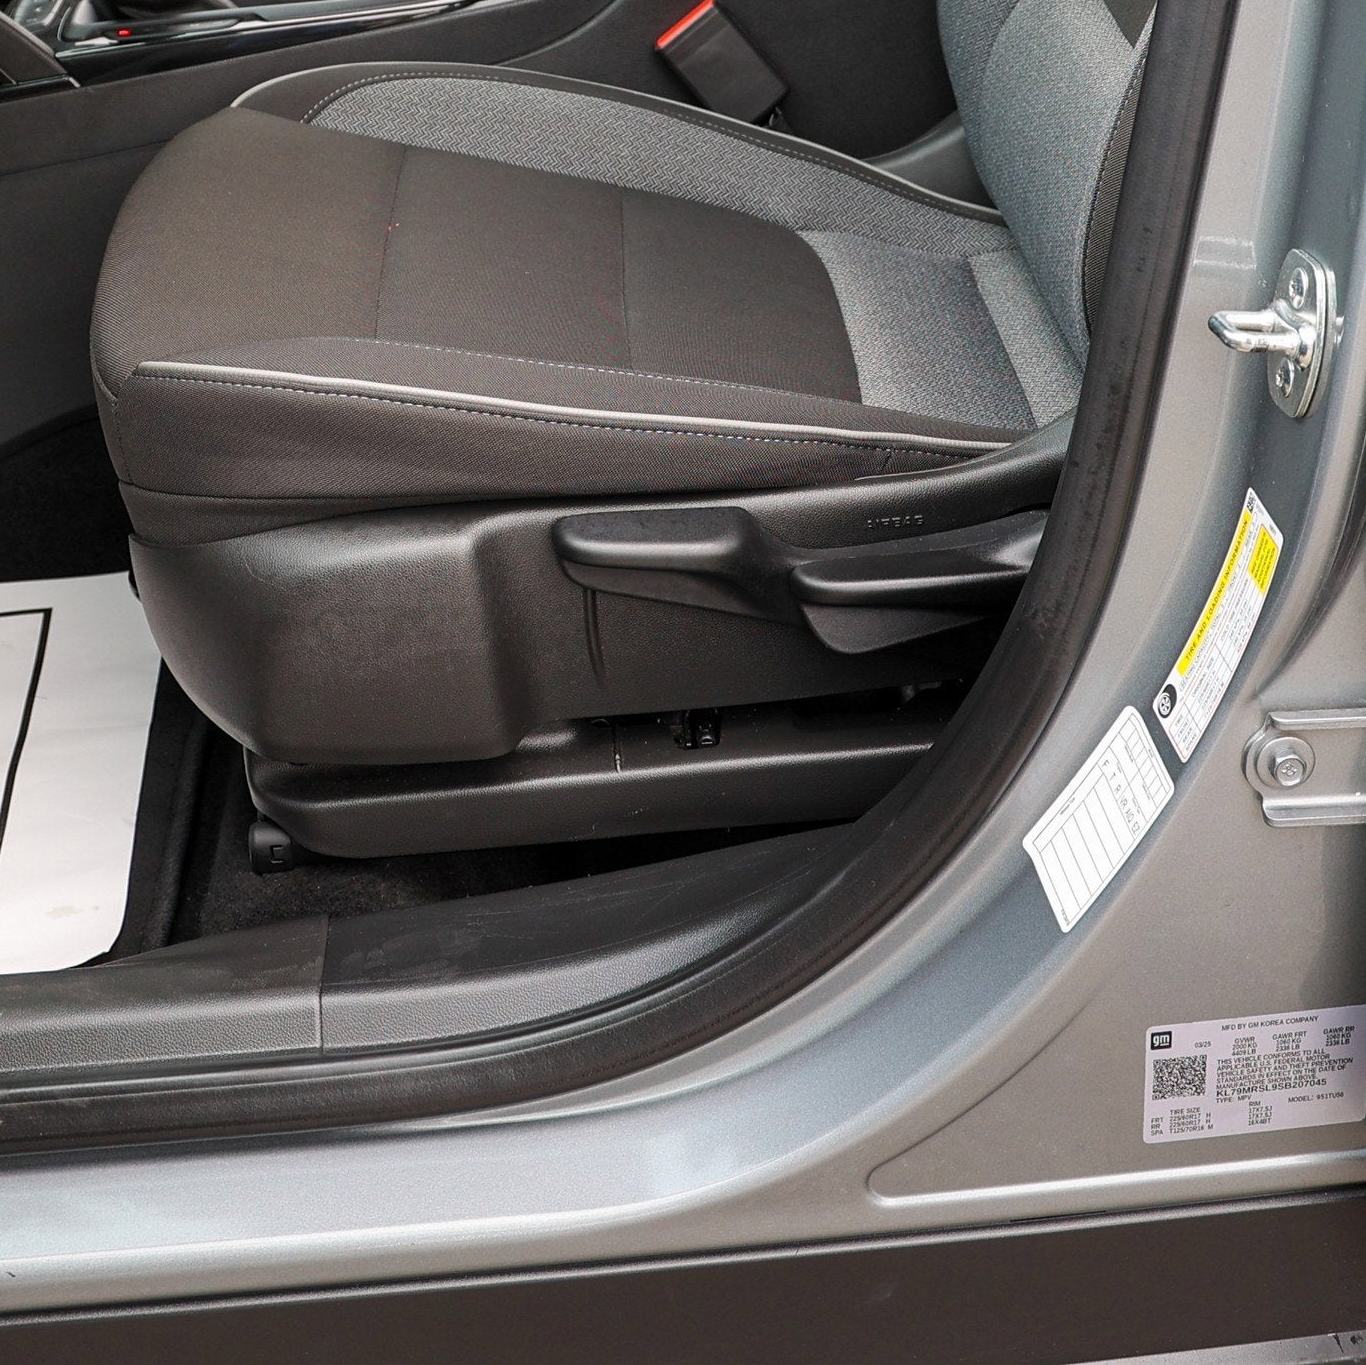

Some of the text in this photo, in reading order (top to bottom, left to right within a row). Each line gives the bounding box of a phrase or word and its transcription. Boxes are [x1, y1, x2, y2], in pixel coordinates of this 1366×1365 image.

[1185, 640, 1198, 661] TIRE
[1196, 621, 1207, 640] AND
[1206, 579, 1225, 622] LOADING
[1224, 518, 1248, 582] INFORMATION
[1261, 1019, 1284, 1027] KOREA
[1285, 1015, 1319, 1024] COMPANY
[1273, 1032, 1293, 1040] GAWR
[1323, 1027, 1344, 1035] GAWR
[1153, 1034, 1170, 1047] gm
[1217, 1062, 1259, 1071] APPLICABLE
[1274, 1057, 1303, 1065] FEDERAL
[1306, 1053, 1330, 1062] MOTOR
[1234, 1055, 1261, 1063] VEHICLE
[1263, 1051, 1301, 1060] CONFORMS
[1217, 1069, 1244, 1078] VEHICLE
[1246, 1066, 1271, 1074] SAFETY
[1312, 1057, 1354, 1067] PREVENTION
[1217, 1074, 1257, 1084] STANDARDS
[1266, 1070, 1292, 1078] EFFECT
[1318, 1065, 1336, 1073] DATE
[1216, 1079, 1266, 1089] MANUFACTURE
[1267, 1076, 1292, 1084] SHOWN
[1216, 1078, 1327, 1097] KL79MRSL9SB207045
[1288, 1095, 1314, 1103] MODEL:
